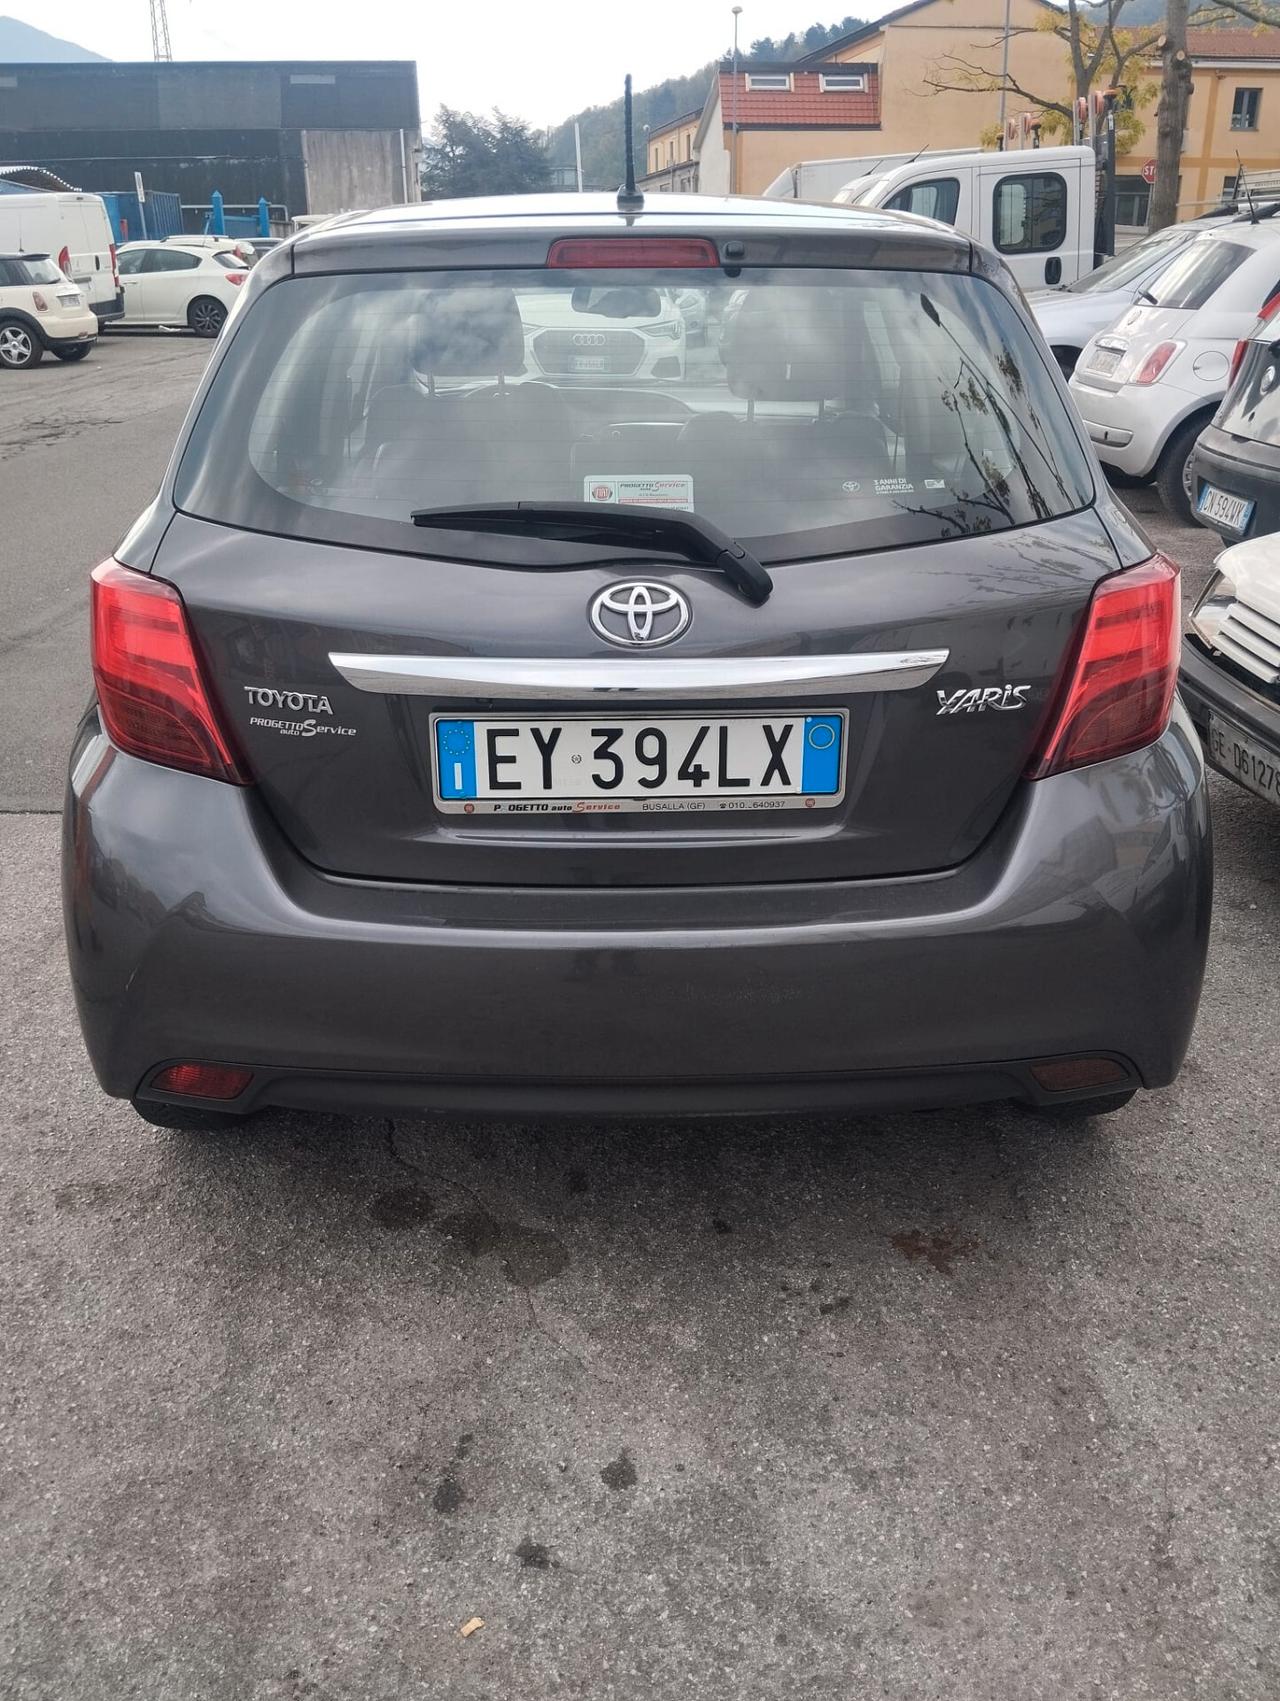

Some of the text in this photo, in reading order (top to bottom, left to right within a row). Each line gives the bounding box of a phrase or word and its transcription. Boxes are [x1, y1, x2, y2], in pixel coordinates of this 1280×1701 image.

[244, 686, 333, 715] TOYOTA
[250, 717, 357, 737] PROGETTO Service
[486, 727, 562, 790] EY
[590, 724, 794, 790] 394LX
[494, 804, 549, 812] POGETTO
[572, 801, 621, 813] Service
[642, 802, 685, 811] BUSALLA
[686, 802, 706, 810] (GE)
